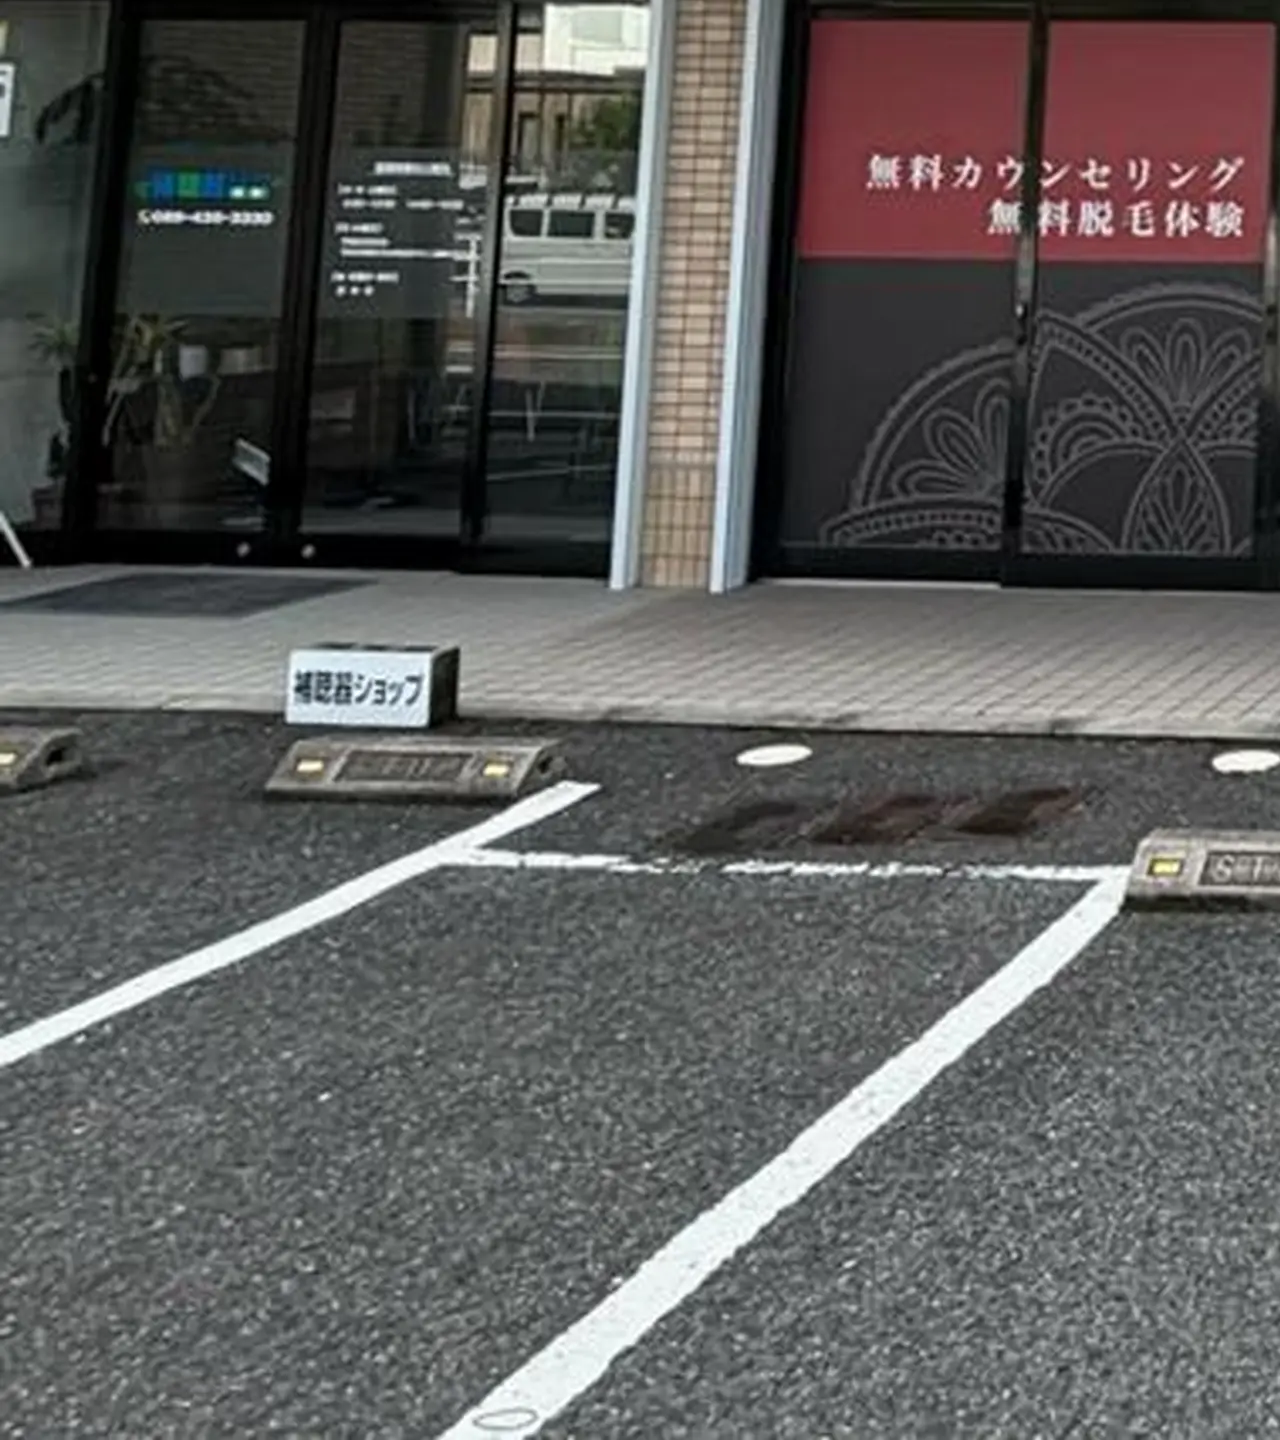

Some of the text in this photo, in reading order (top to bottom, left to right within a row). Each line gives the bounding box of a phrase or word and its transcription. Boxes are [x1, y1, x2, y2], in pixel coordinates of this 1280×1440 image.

[865, 153, 1246, 191] 無料カウンセリング
[986, 198, 1245, 238] 無料脱毛体験
[293, 669, 424, 707] 補聴器ショップ
